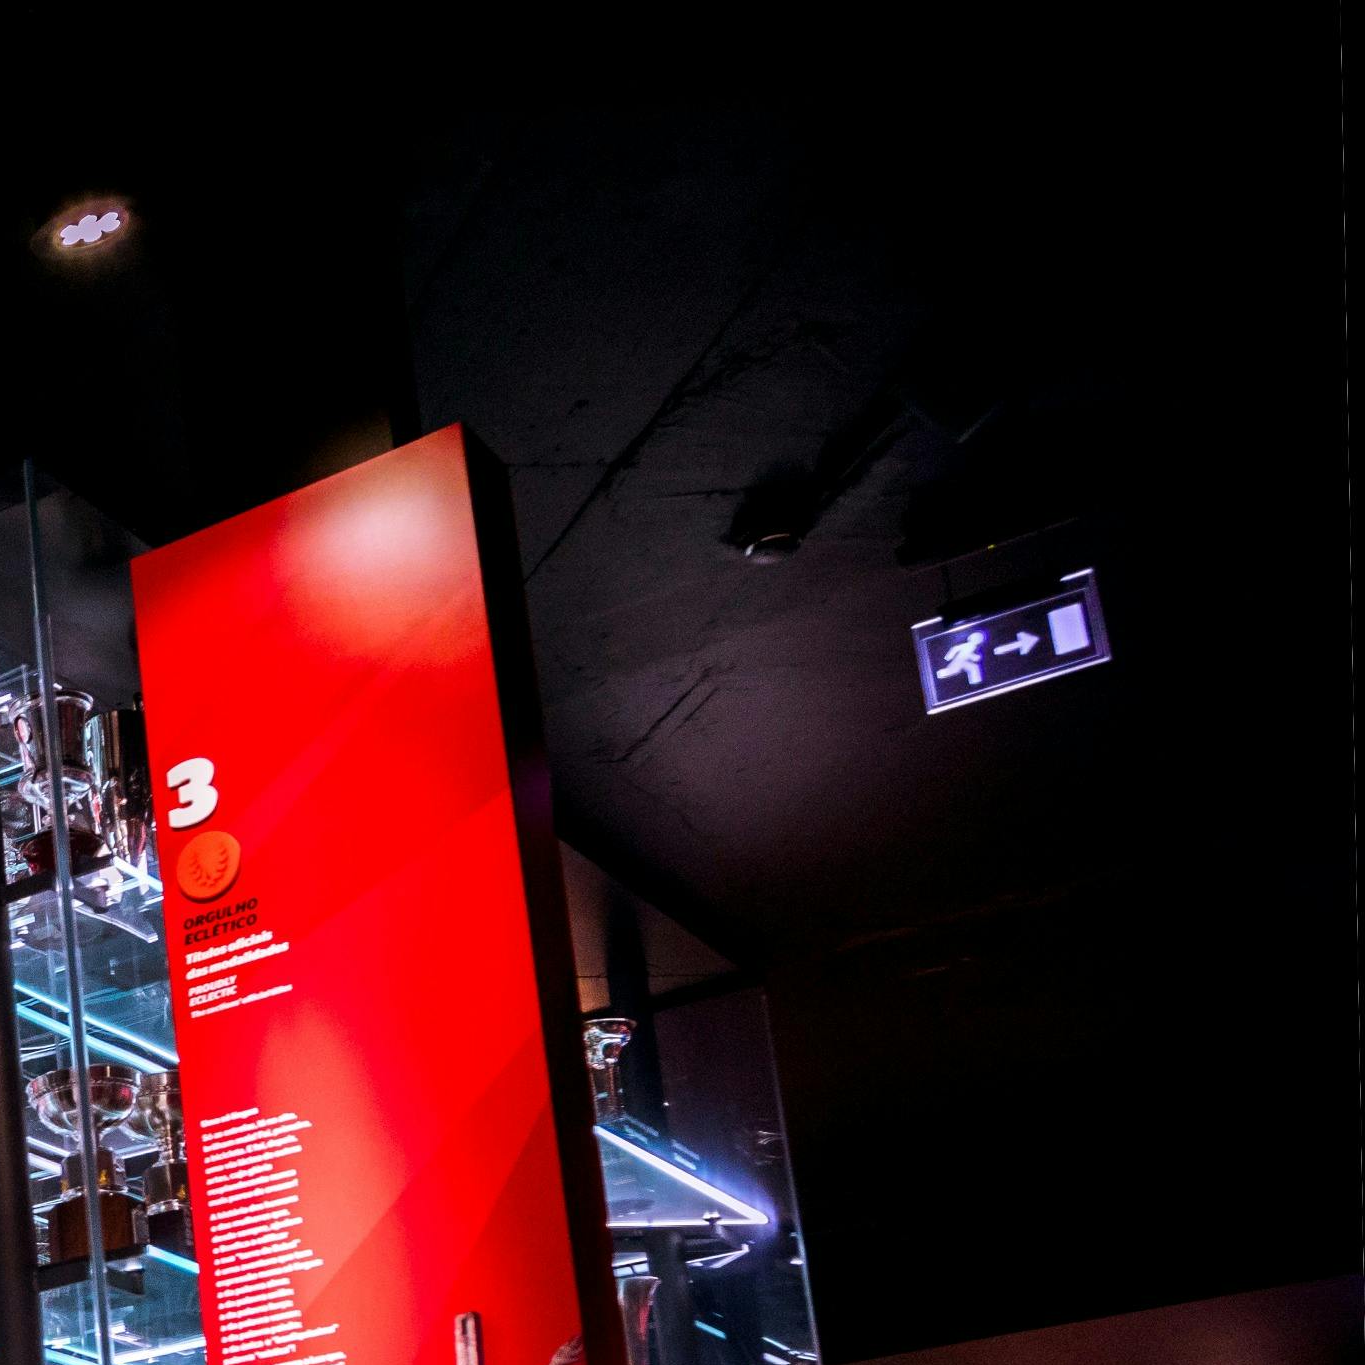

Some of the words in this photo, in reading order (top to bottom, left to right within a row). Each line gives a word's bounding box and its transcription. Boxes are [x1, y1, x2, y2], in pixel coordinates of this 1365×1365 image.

[166, 757, 219, 829] 3
[183, 898, 258, 929] ORGULHO
[184, 914, 257, 945] ECLÉTICO
[189, 985, 237, 1007] ECLECTIC
